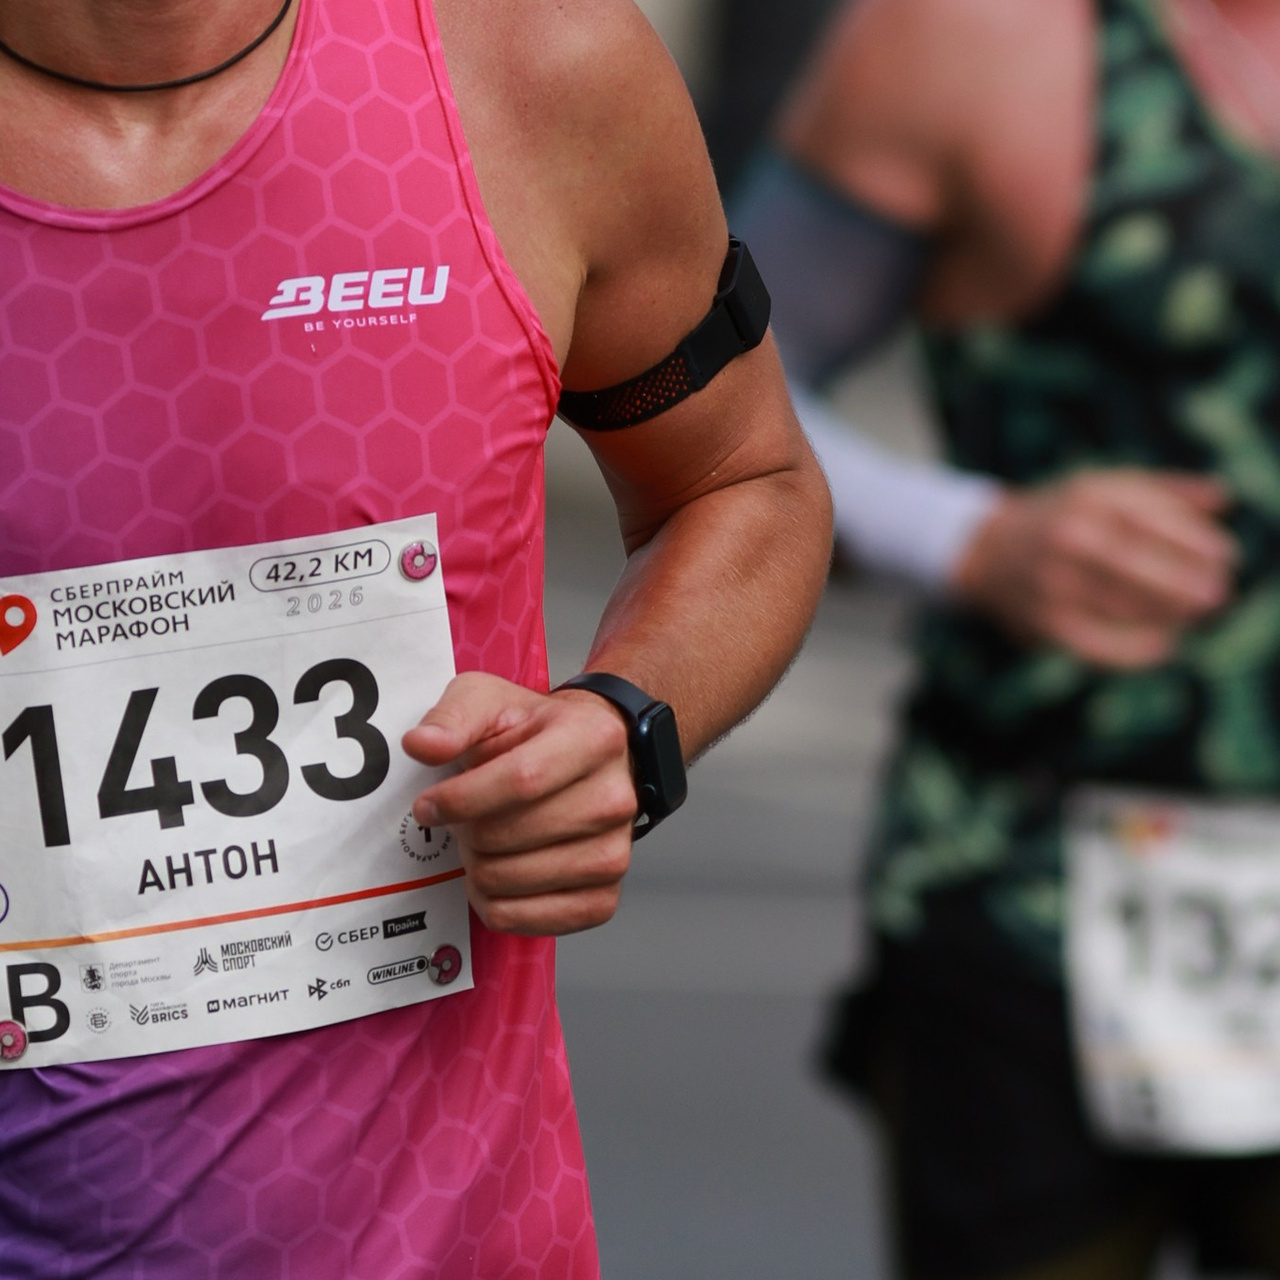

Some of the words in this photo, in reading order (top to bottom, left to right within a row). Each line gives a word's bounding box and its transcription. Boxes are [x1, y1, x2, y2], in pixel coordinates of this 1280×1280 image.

[261, 265, 450, 321] BEEU
[304, 322, 324, 332] BE
[332, 313, 418, 330] YOURSELF
[266, 557, 322, 583] 42,2
[50, 570, 184, 603] СБЕРПРАЙМ
[53, 580, 235, 627] МОСКОВСКИЙ
[286, 586, 364, 617] 2026
[56, 613, 190, 651] МАРАФОН
[1, 657, 391, 848] 1433
[137, 838, 280, 896] АНТОН
[220, 931, 293, 958] МОСКОВСКИЙ
[337, 925, 380, 945] СБЕР
[386, 918, 420, 935] Прайм
[109, 957, 161, 971] Департамент
[110, 970, 138, 980] спорта
[222, 954, 256, 972] СПОРТ
[371, 962, 416, 982] WINLINE
[111, 979, 139, 989] города
[140, 974, 172, 985] Москвы
[329, 979, 351, 991] сбп
[151, 1009, 189, 1024] BRICS
